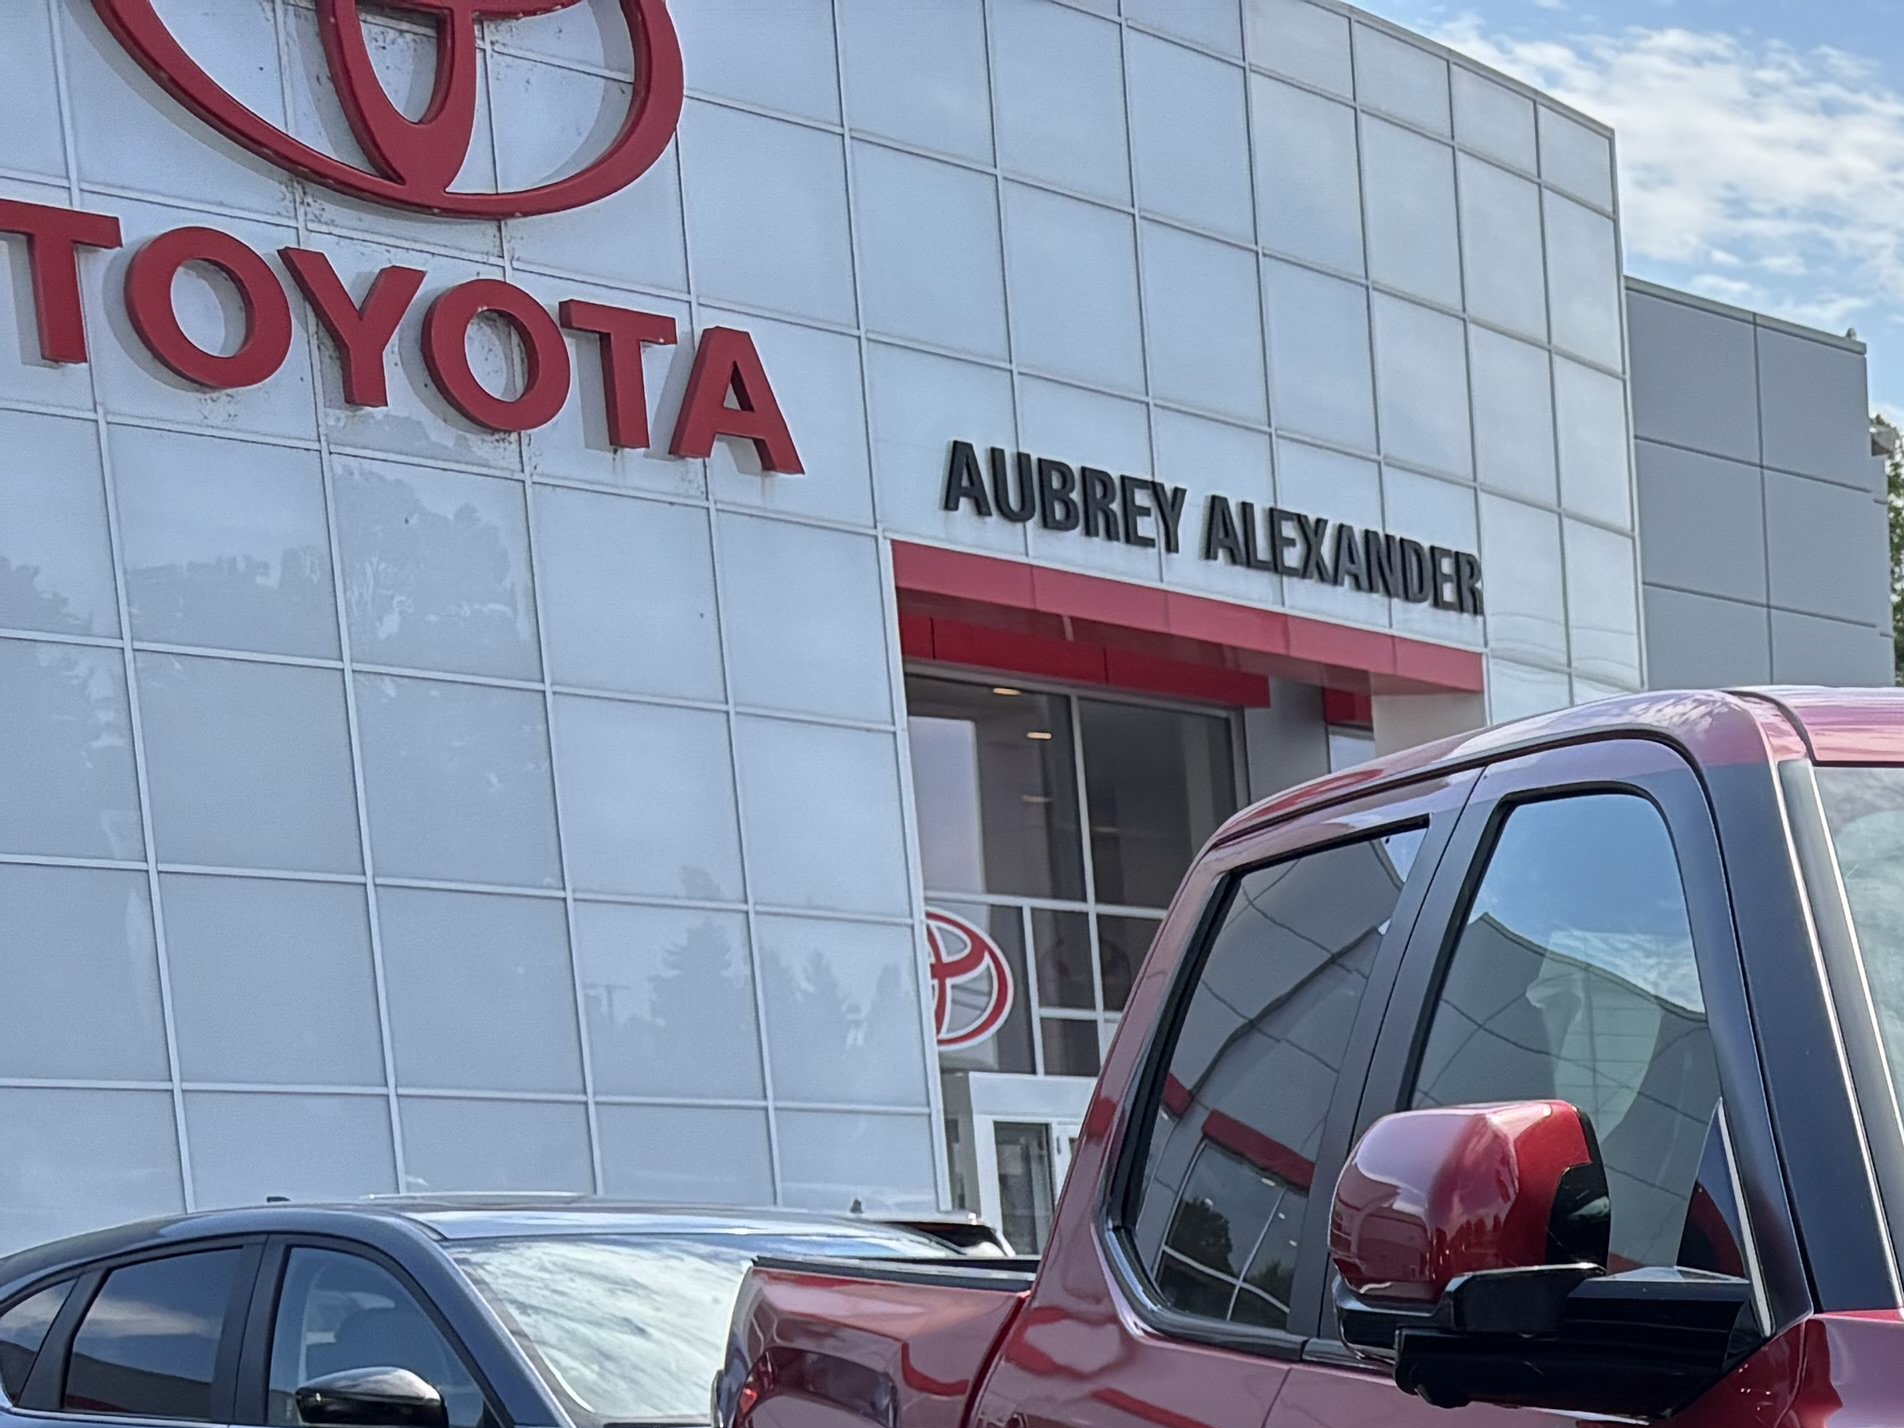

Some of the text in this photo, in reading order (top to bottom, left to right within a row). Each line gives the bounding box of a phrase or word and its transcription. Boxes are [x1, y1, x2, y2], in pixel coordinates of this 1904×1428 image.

[0, 202, 804, 475] TOYOTA
[945, 440, 1483, 615] AUBREY ALEXANDER
